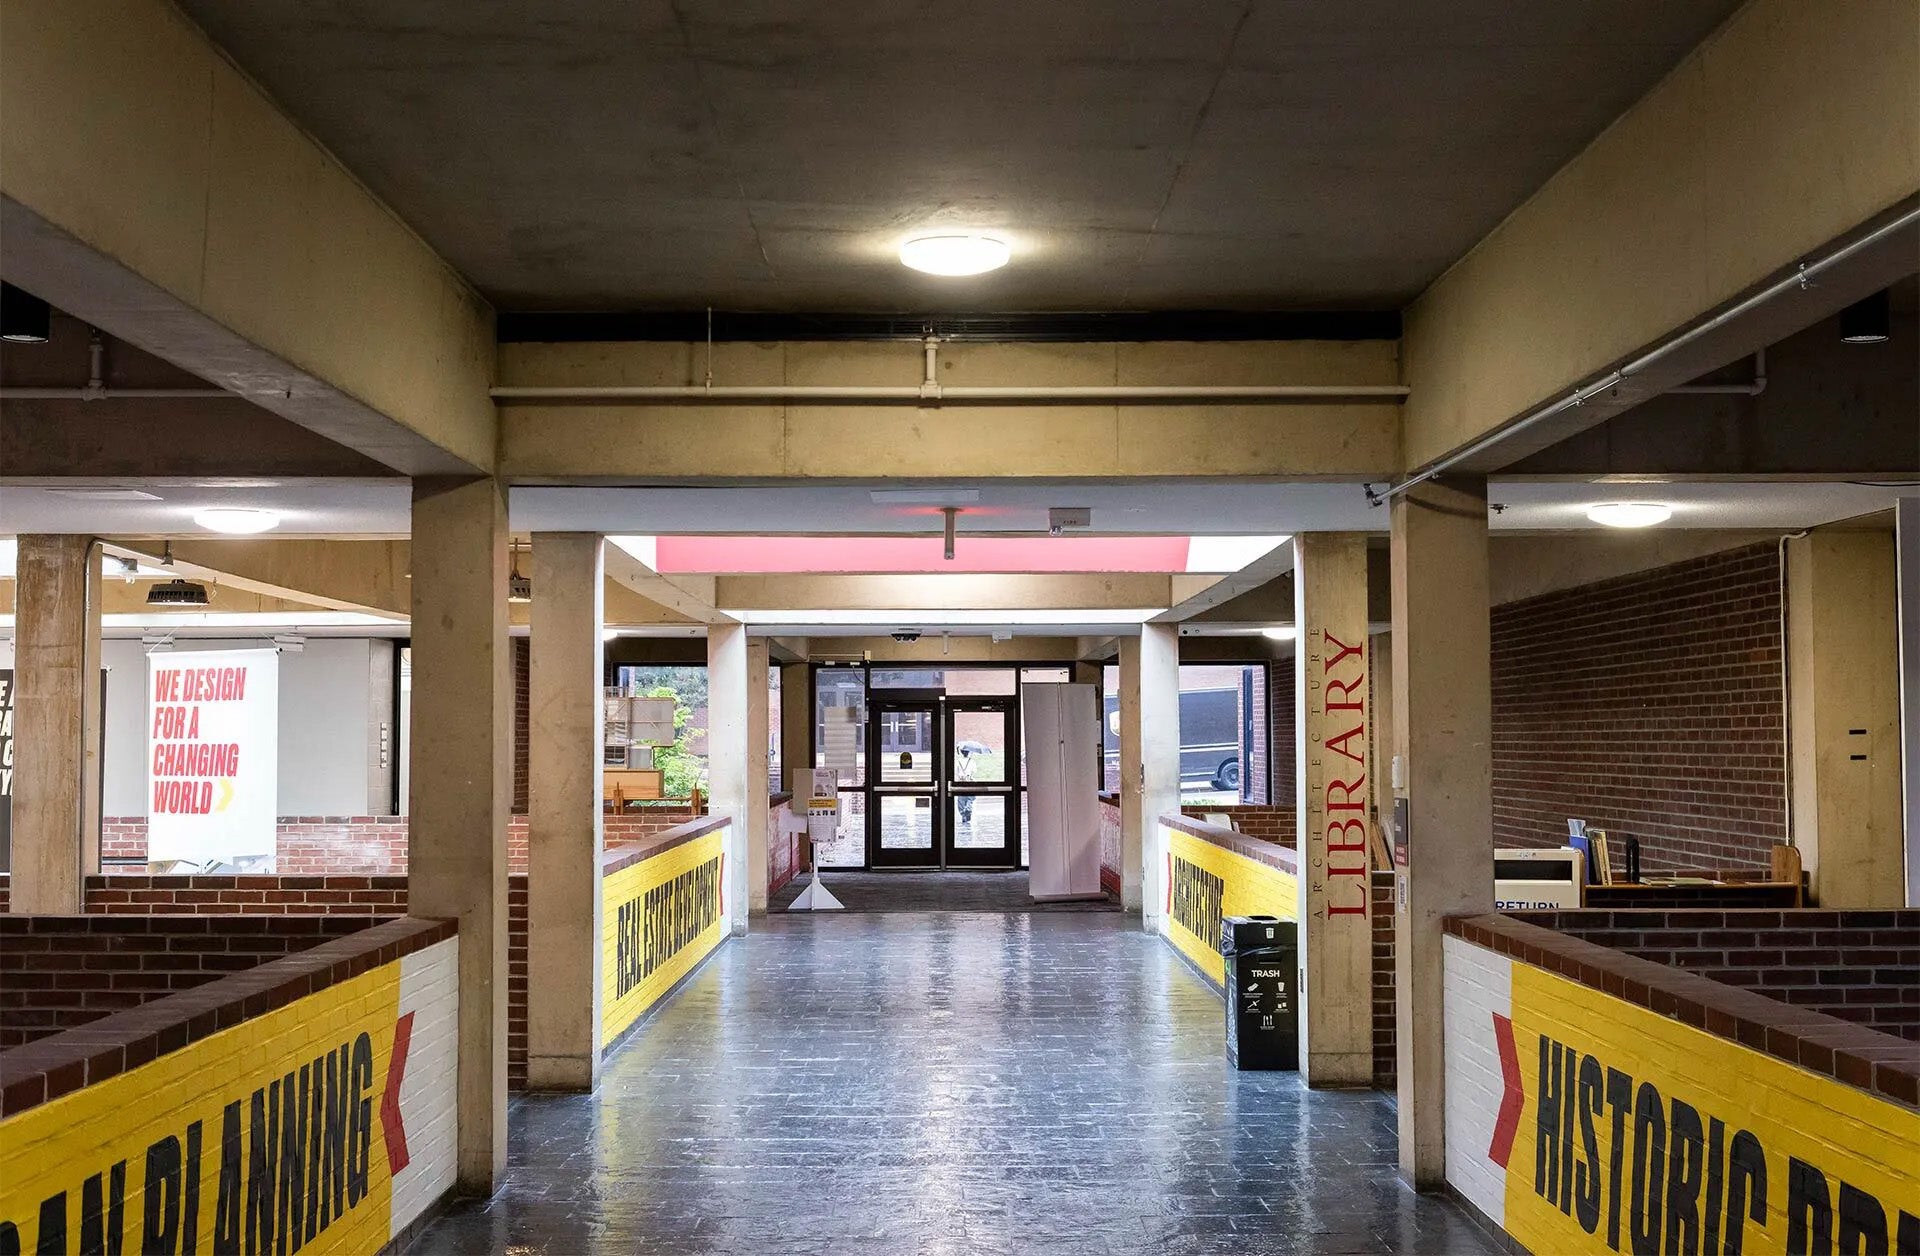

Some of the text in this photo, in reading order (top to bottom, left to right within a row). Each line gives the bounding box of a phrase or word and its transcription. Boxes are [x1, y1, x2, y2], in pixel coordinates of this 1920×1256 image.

[153, 706, 199, 739] FOR A
[156, 667, 247, 702] WE DESIGN
[153, 743, 239, 777] CHANGING
[154, 781, 213, 814] WORLD
[1310, 629, 1323, 919] ARCHITECTURE
[1325, 628, 1366, 920] LIBRARY
[616, 896, 642, 1001] REAL
[643, 879, 673, 979] ESTATE
[1251, 970, 1280, 978] TRASH
[142, 1031, 373, 1256] PLANNING
[1535, 1034, 1768, 1256] HISTORIC
